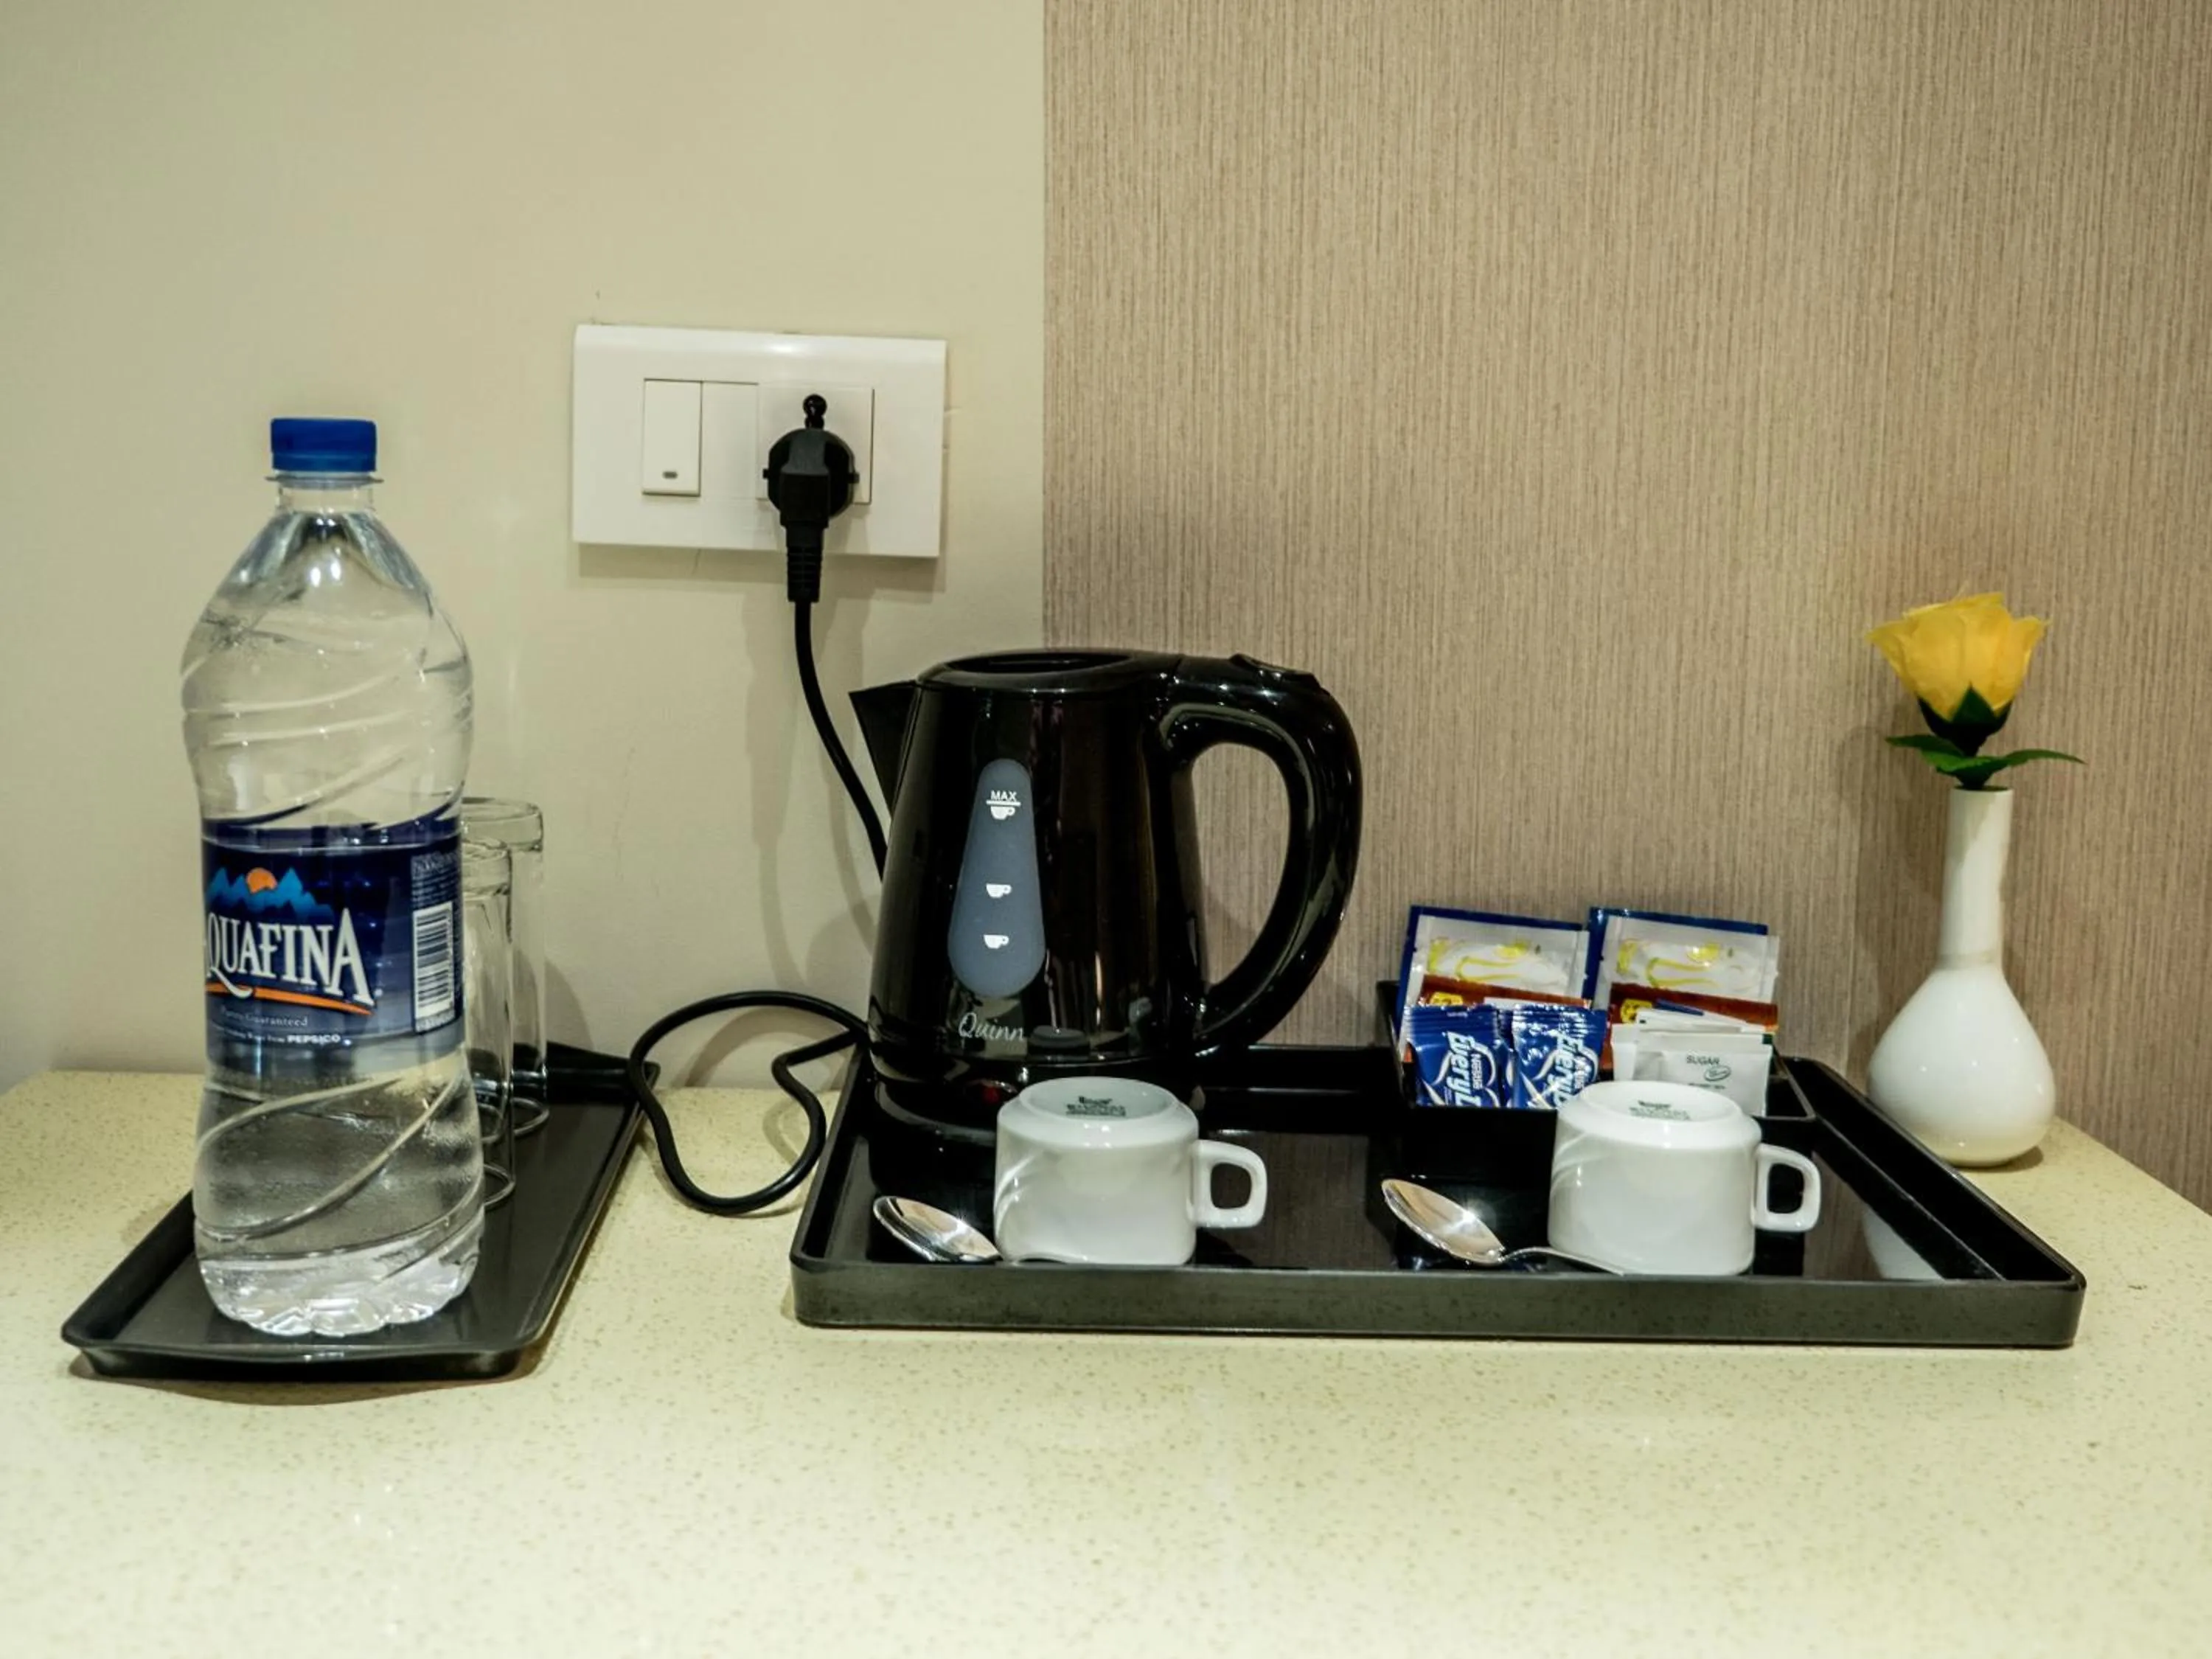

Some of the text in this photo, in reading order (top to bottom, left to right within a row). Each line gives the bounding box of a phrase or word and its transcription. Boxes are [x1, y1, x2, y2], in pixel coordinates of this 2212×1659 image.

[990, 790, 1017, 801] MAX
[207, 908, 375, 1006] QUAFINA
[959, 1012, 1024, 1041] Quinn
[288, 1034, 341, 1045] PEPSICO
[1686, 1054, 1719, 1065] SUGAR
